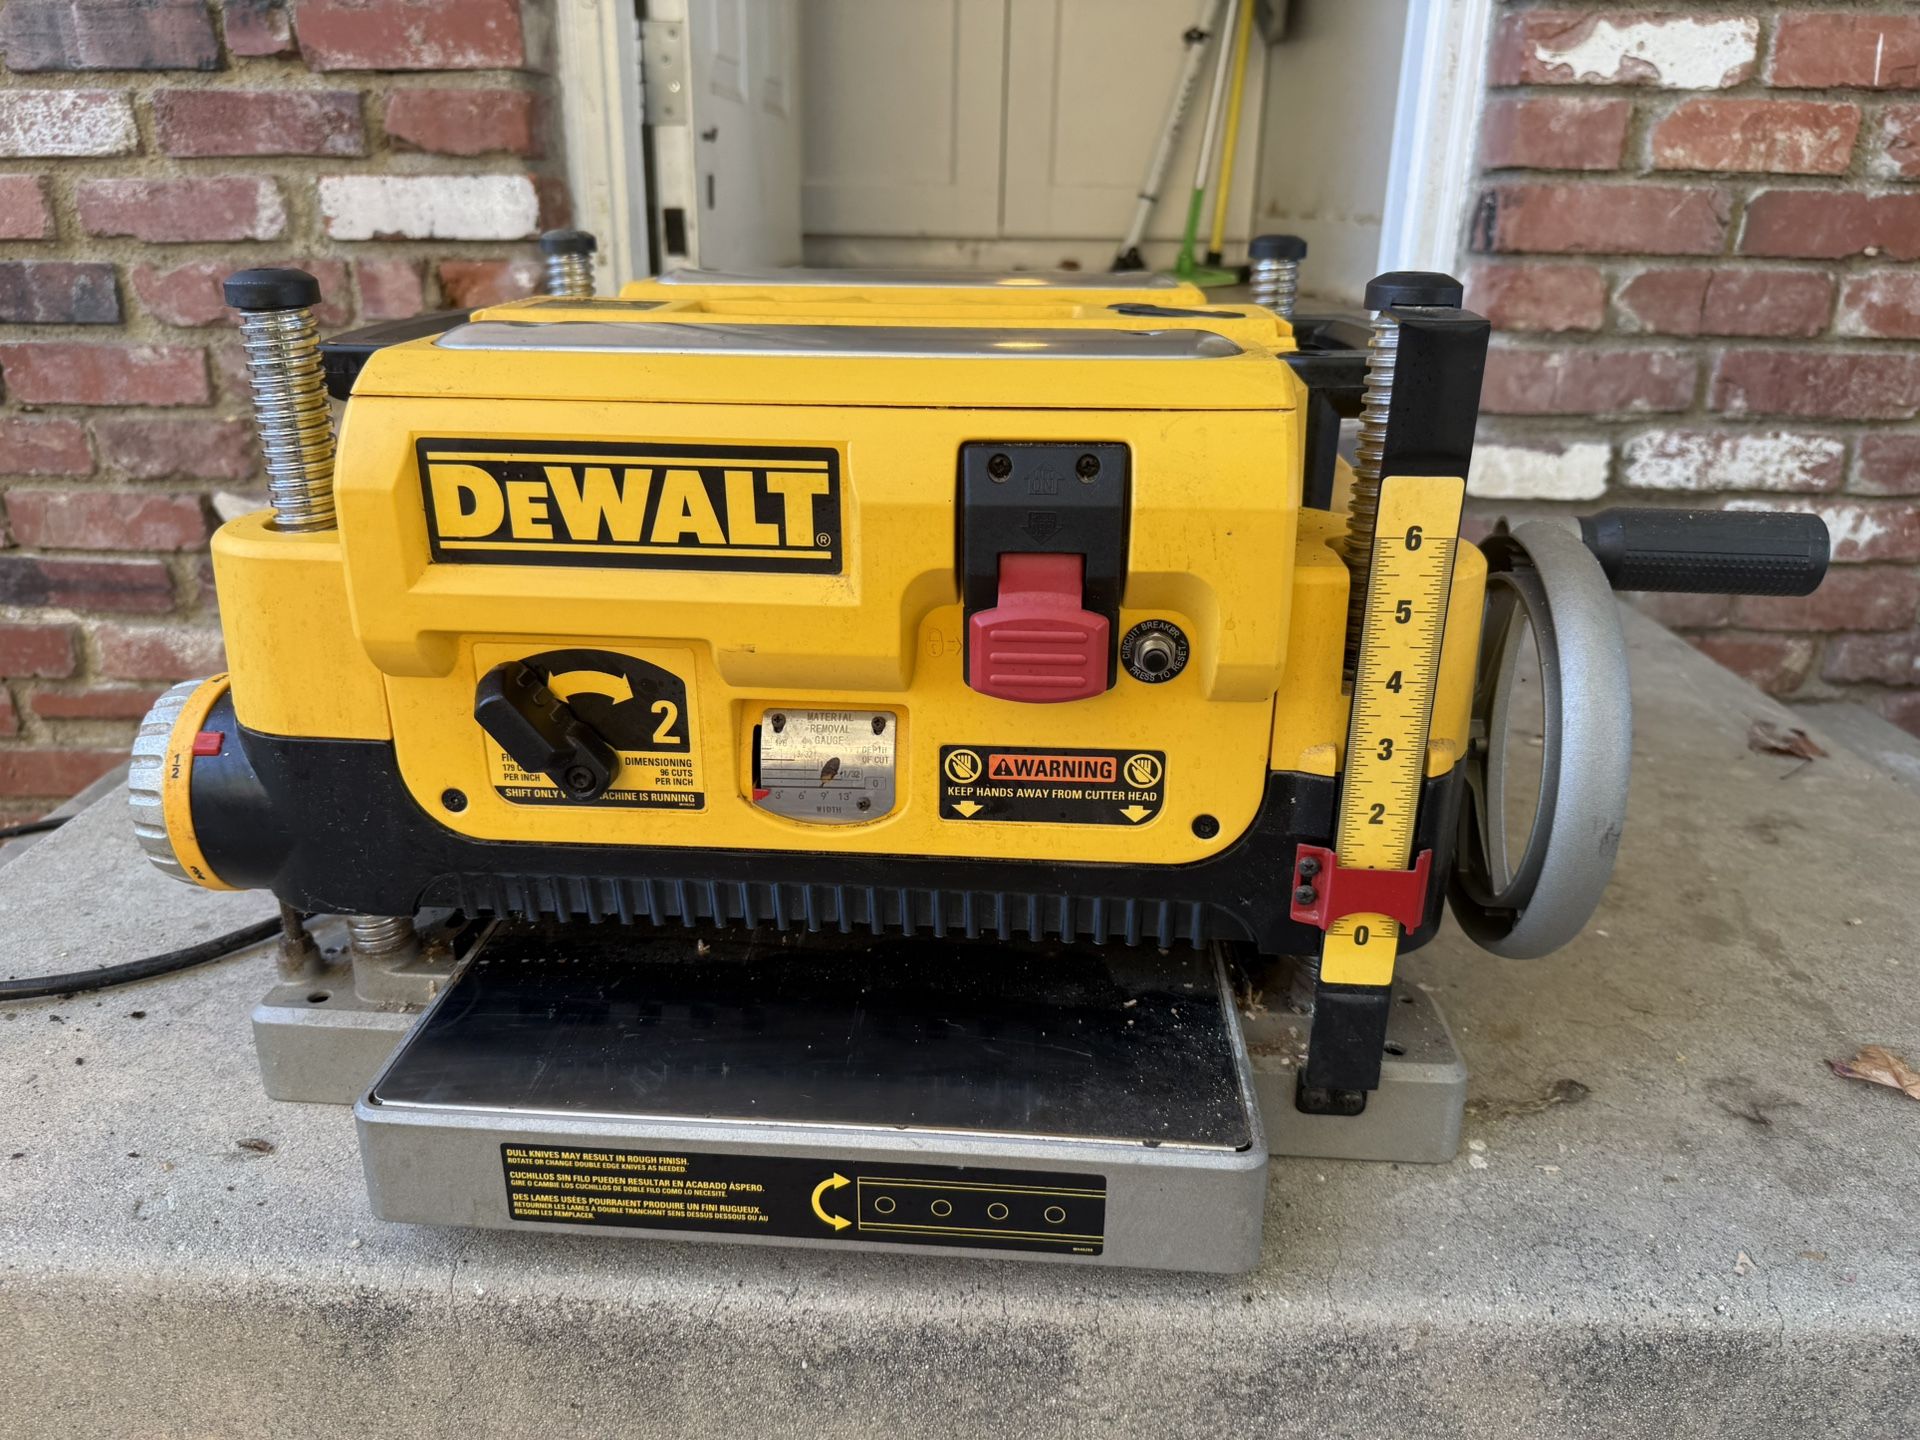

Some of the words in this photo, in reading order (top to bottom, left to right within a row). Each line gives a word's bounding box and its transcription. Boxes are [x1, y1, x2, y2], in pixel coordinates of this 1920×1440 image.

[1405, 526, 1422, 550] 6
[1395, 601, 1412, 623] 5
[1122, 627, 1140, 659] CIRCUIT
[1141, 621, 1180, 638] BREAKER
[1130, 666, 1155, 681] PRESS
[1158, 671, 1170, 680] TO
[1386, 671, 1403, 693] 4
[651, 700, 681, 744] 2
[807, 712, 853, 722] MATERIAL
[810, 724, 850, 733] REMOVAL
[814, 735, 844, 744] GAUGE
[862, 746, 887, 754] DEPTH
[1377, 739, 1393, 760] 3
[625, 757, 692, 768] DIMENSIONING
[862, 756, 872, 764] OF
[875, 756, 889, 764] CUT
[660, 768, 669, 776] 96
[672, 769, 692, 777] CUTS
[1014, 759, 1112, 779] WARNING
[504, 773, 519, 781] PER
[521, 773, 540, 782] INCH
[655, 777, 671, 785] PER
[673, 778, 693, 786] INCH
[873, 779, 878, 787] 0
[505, 788, 532, 797] SHIFT
[534, 789, 559, 798] ONLY
[600, 792, 638, 801] ACHINE
[639, 793, 649, 801] IS
[651, 793, 695, 802] RUNNING
[948, 787, 973, 796] KEEP
[977, 788, 1013, 798] HANDS
[1017, 789, 1049, 798] AWAY
[1052, 789, 1082, 799] FROM
[1085, 790, 1125, 800] CUTTER
[1128, 792, 1157, 802] HEAD
[1368, 804, 1385, 825] 2
[1353, 926, 1369, 945] 0
[506, 1148, 528, 1157] DULL
[529, 1150, 559, 1158] KNIVES
[561, 1152, 581, 1160] MAY
[583, 1153, 614, 1161] RESULT
[616, 1154, 625, 1162] IN
[627, 1155, 657, 1164] ROUGH
[659, 1157, 689, 1165] FINISH.
[509, 1171, 555, 1180] CUCHILLOS
[556, 1173, 571, 1181] SIN
[573, 1174, 590, 1182] FILO
[592, 1176, 626, 1184] PUEDEN
[627, 1178, 671, 1187] RESULTAR
[686, 1181, 727, 1190] ACABADO
[575, 1183, 612, 1191] CUCHILLOS
[513, 1193, 529, 1201] DES
[531, 1194, 559, 1203] LAMES
[589, 1198, 641, 1207] POURRAIENT
[644, 1201, 685, 1210] PRODUIRE
[687, 1203, 699, 1211] UN
[701, 1204, 717, 1212] FINI
[720, 1205, 761, 1214] RUGUEUX.
[514, 1201, 552, 1209] RETOURNER
[625, 1208, 666, 1216] TRANCHANT
[714, 1212, 746, 1220] DESSOUS
